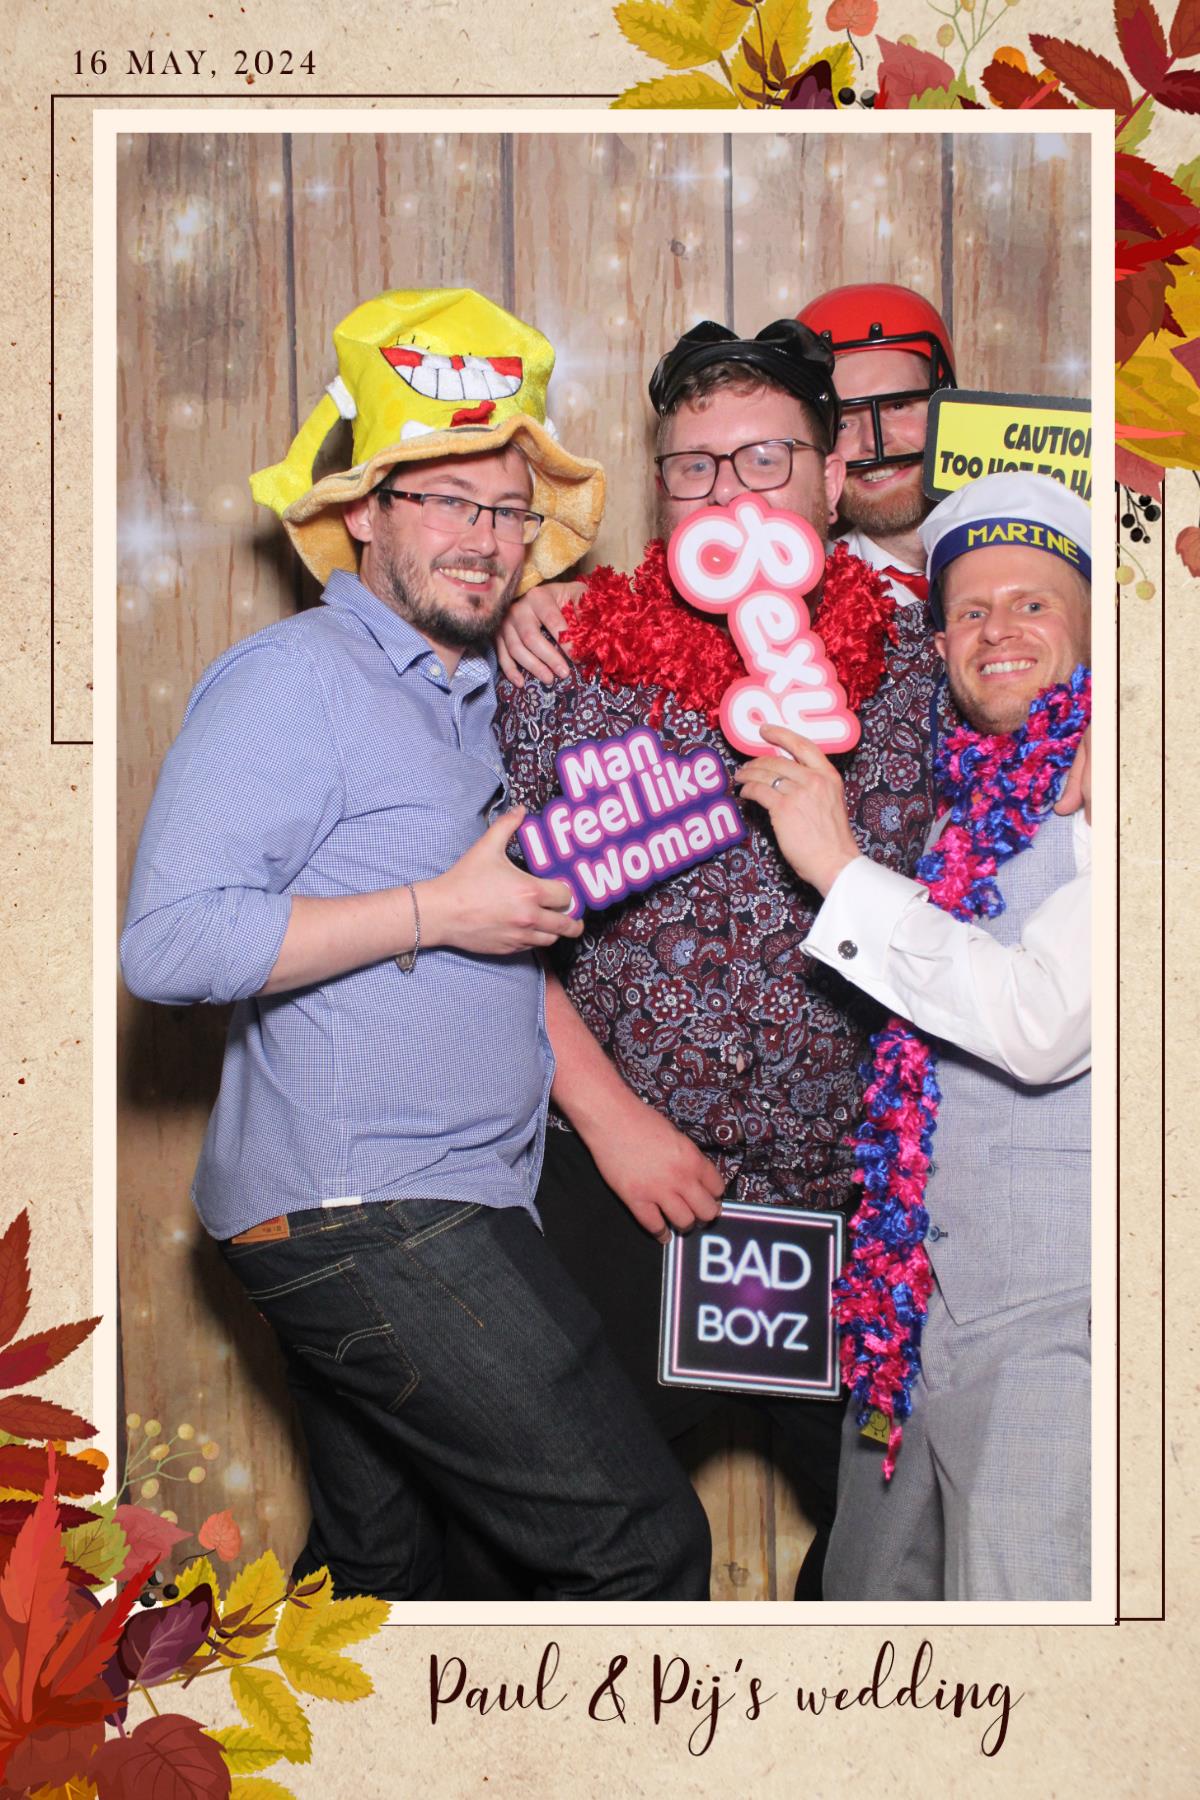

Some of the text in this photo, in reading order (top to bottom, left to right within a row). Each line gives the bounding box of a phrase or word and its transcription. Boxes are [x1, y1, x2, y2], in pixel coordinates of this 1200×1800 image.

[940, 451, 983, 479] TOO
[967, 522, 1080, 564] MARINE
[679, 499, 851, 745] Sexy
[564, 735, 659, 798] Man
[525, 756, 720, 866] I feel like
[699, 1234, 812, 1291] BAD
[697, 1305, 809, 1351] BOYZ
